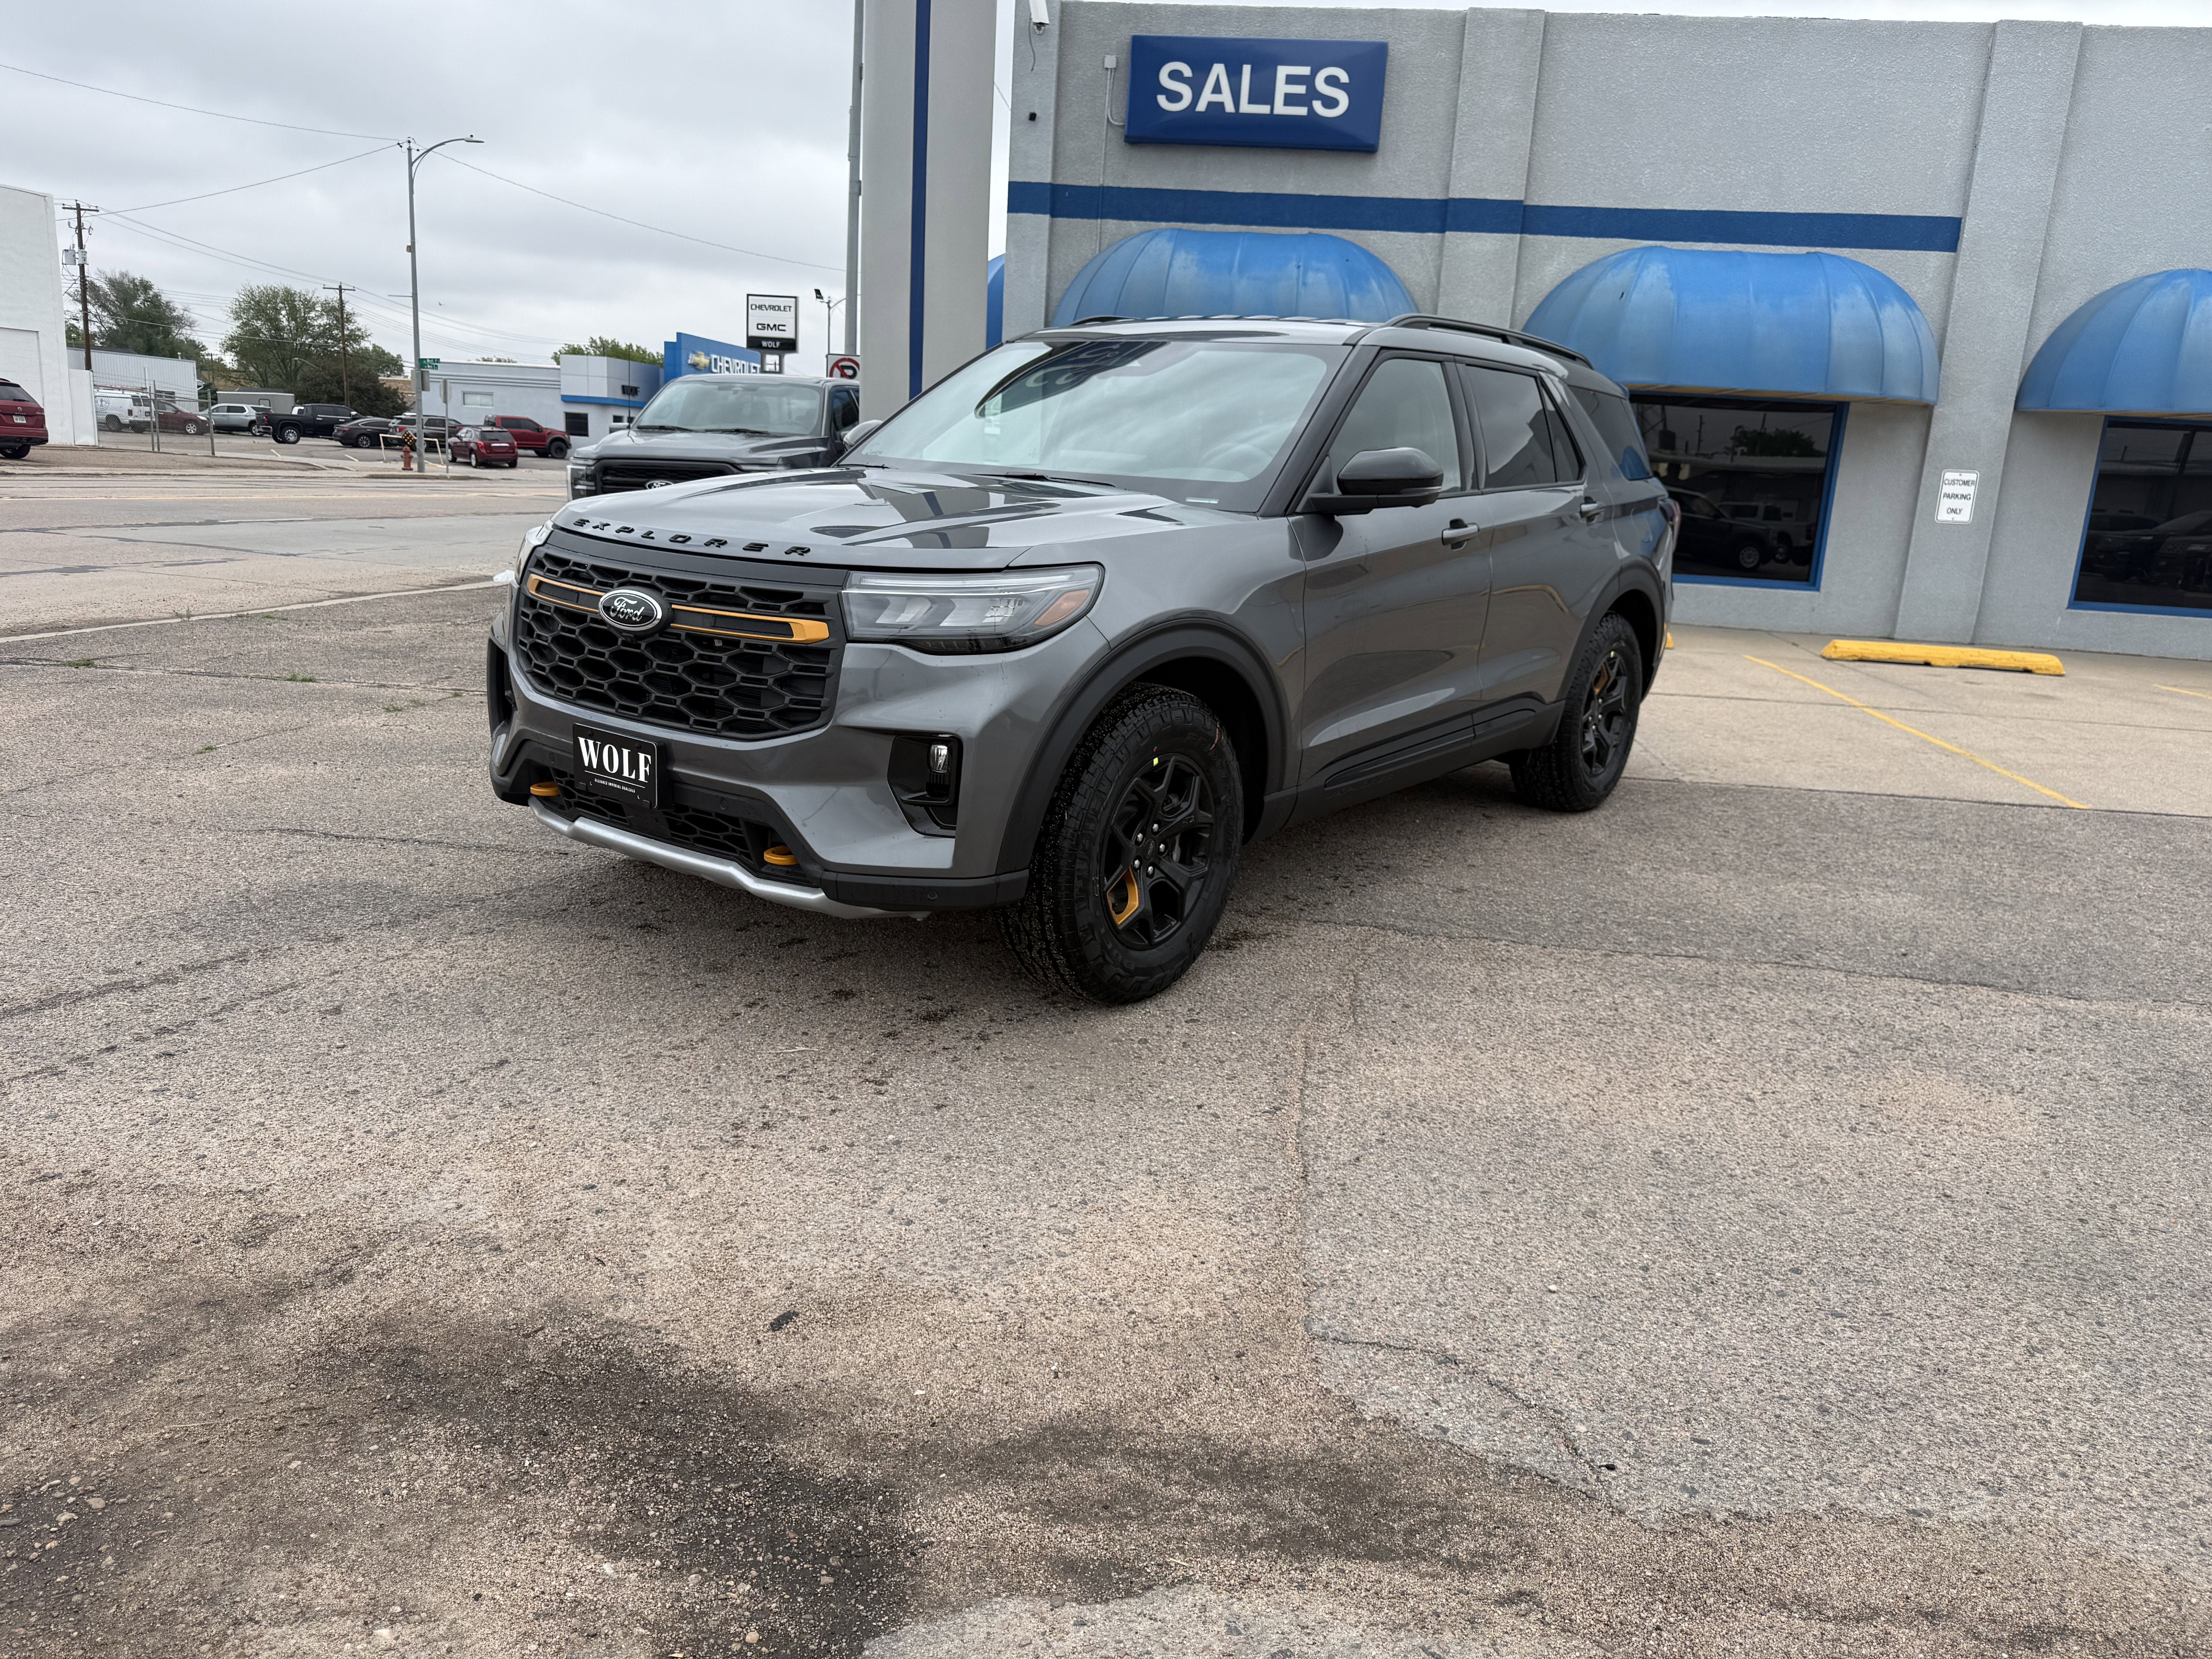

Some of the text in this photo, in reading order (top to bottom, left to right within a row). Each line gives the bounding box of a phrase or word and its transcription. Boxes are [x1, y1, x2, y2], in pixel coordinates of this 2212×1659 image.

[1156, 61, 1350, 117] SALES
[750, 304, 793, 312] CHEVROLET
[756, 323, 787, 332] GMC
[761, 340, 781, 348] WOLF
[1944, 478, 1975, 487] CUSTOMER
[1942, 492, 1972, 501] PARKING
[1946, 507, 1963, 515] ONLY
[573, 518, 811, 556] EXPLORER
[609, 596, 645, 622] Ford
[577, 737, 651, 783] WOLF
